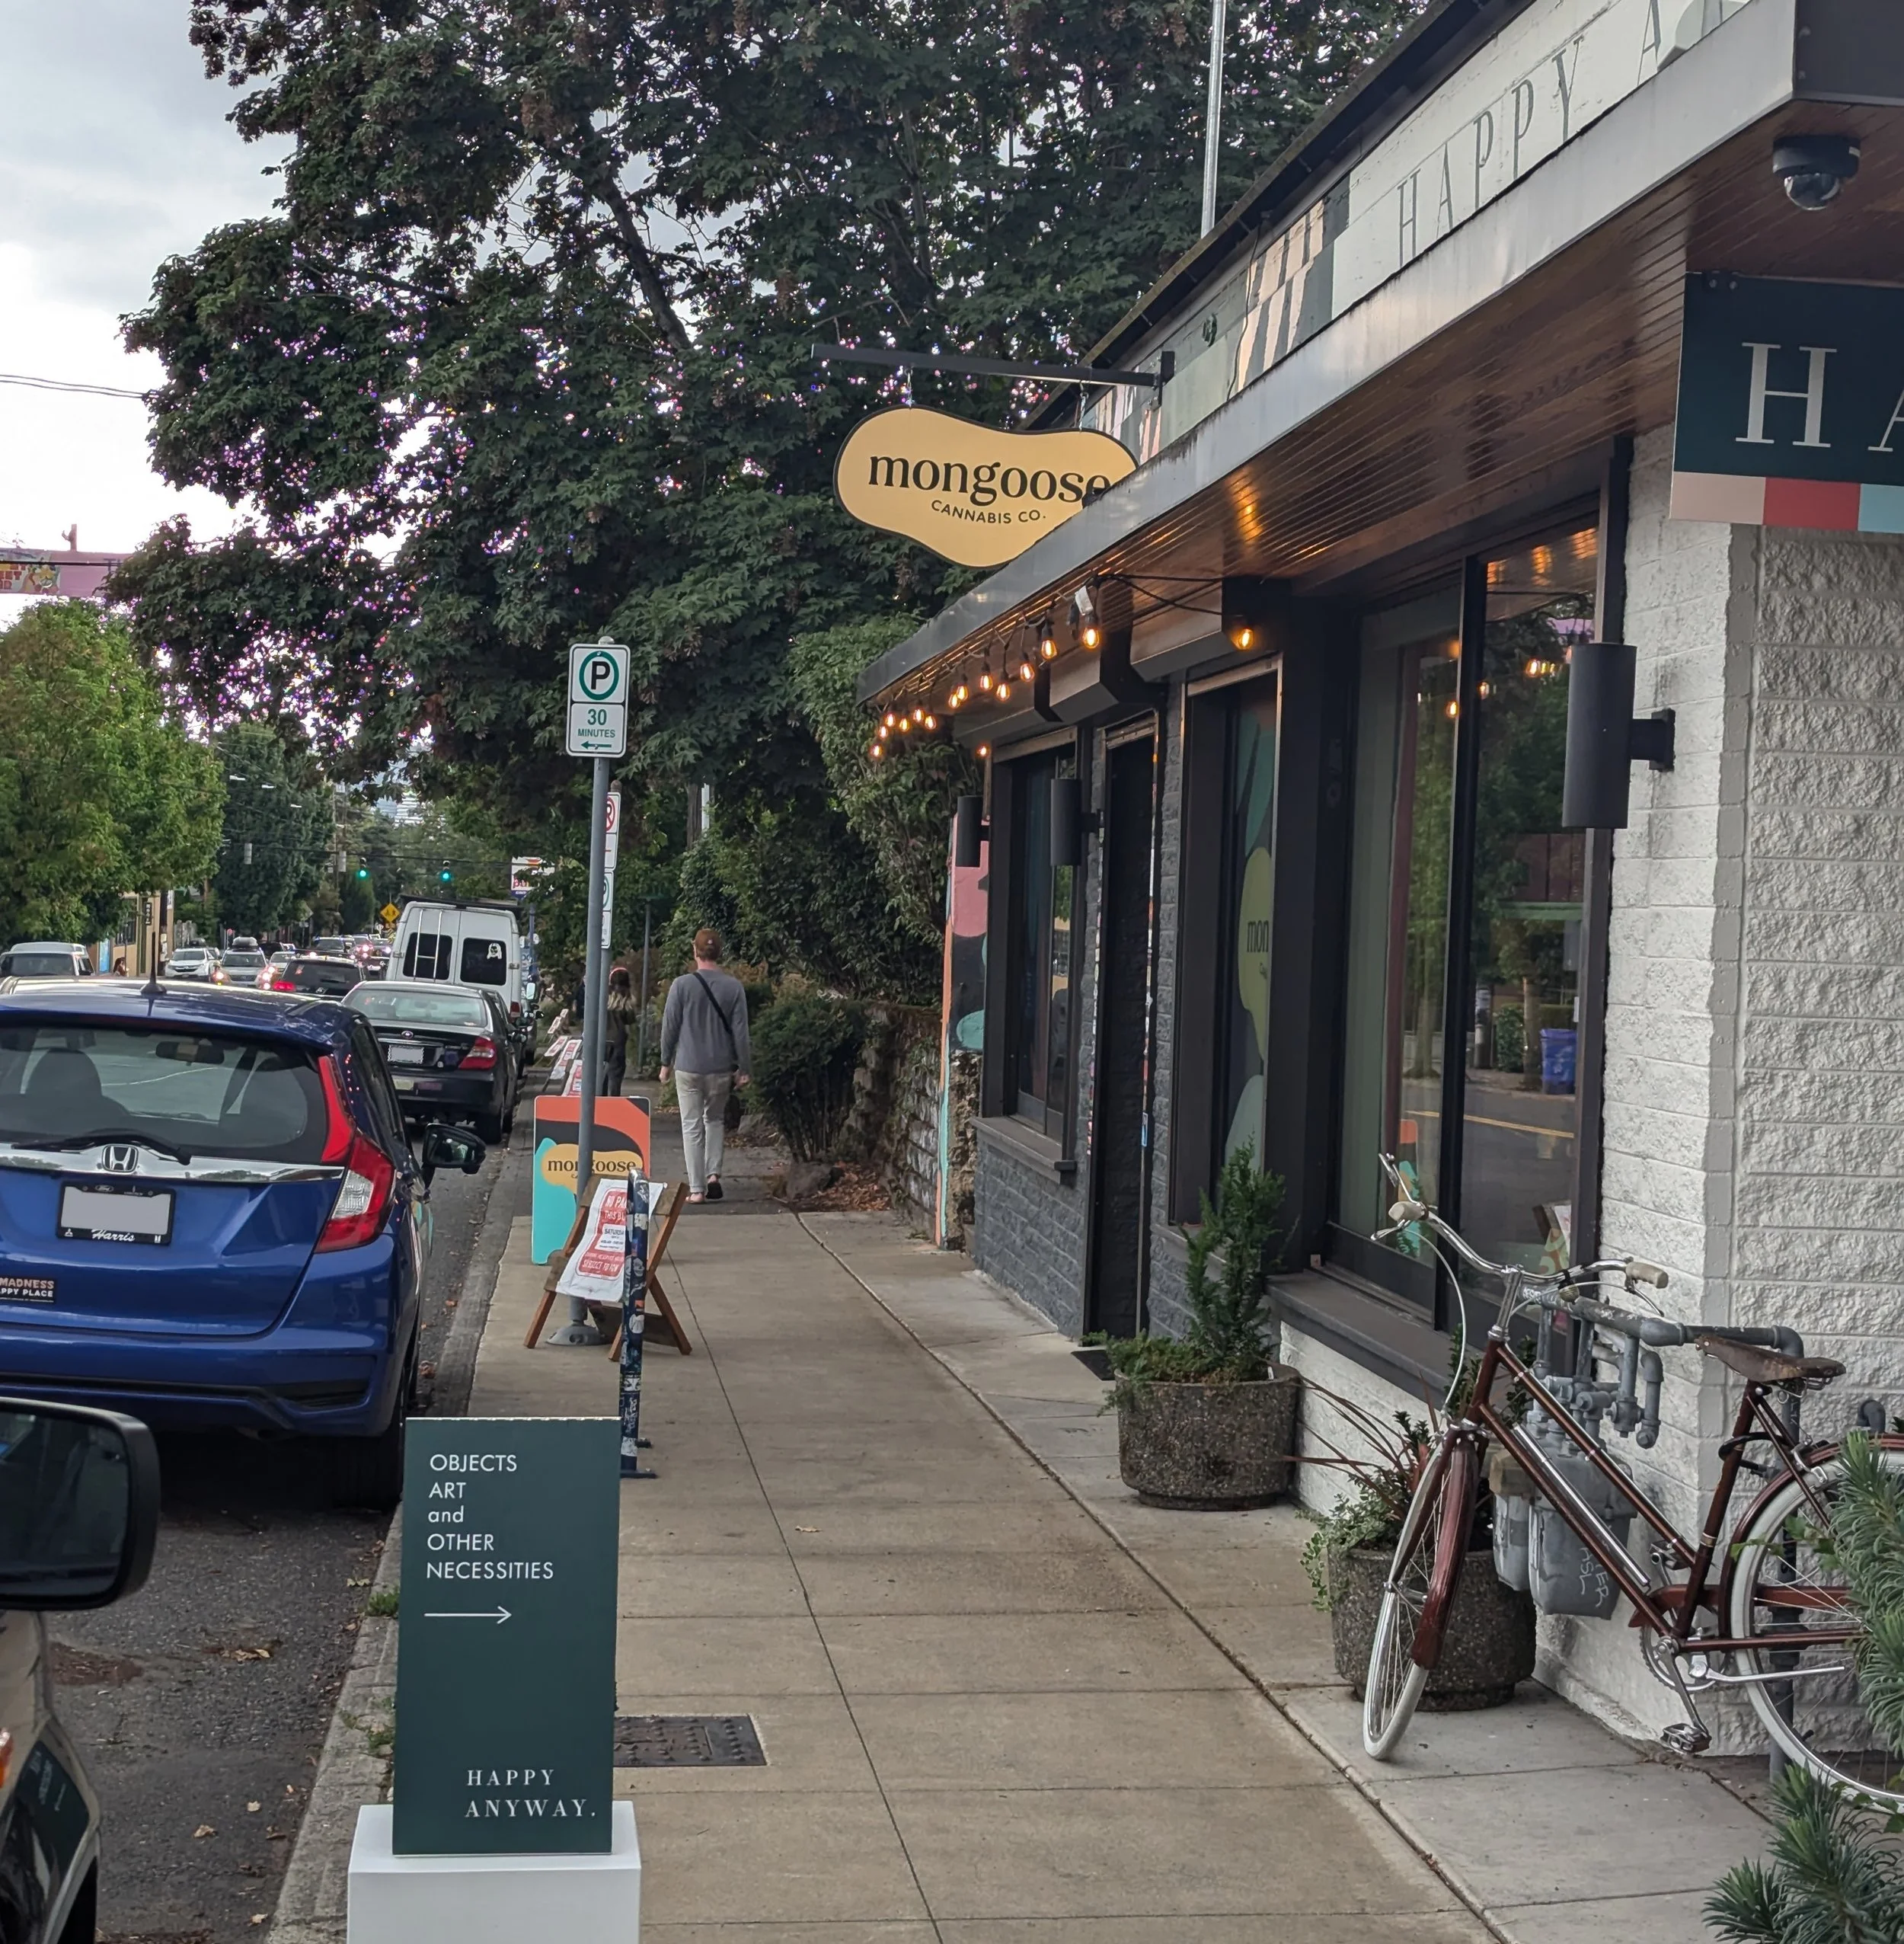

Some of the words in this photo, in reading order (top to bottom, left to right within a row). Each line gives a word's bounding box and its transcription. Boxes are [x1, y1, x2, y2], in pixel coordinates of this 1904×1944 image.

[1397, 37, 1585, 268] HAPPY
[931, 500, 1012, 524] CANNABIS
[1018, 509, 1046, 523] CO.
[590, 660, 611, 690] P
[587, 708, 608, 727] 30
[577, 728, 615, 739] MINUTES
[548, 1159, 636, 1173] mooose
[91, 1229, 136, 1242] Harris
[0, 1277, 55, 1289] MADNESS
[22, 1289, 53, 1297] PLACE
[430, 1453, 517, 1472] OBJECTS
[428, 1482, 466, 1499] ART
[427, 1505, 465, 1523] and
[426, 1533, 495, 1552] OTHER
[426, 1562, 554, 1580] NECESSITIES
[466, 1769, 554, 1786] HAPPY
[465, 1799, 597, 1818] ANYWAY.
